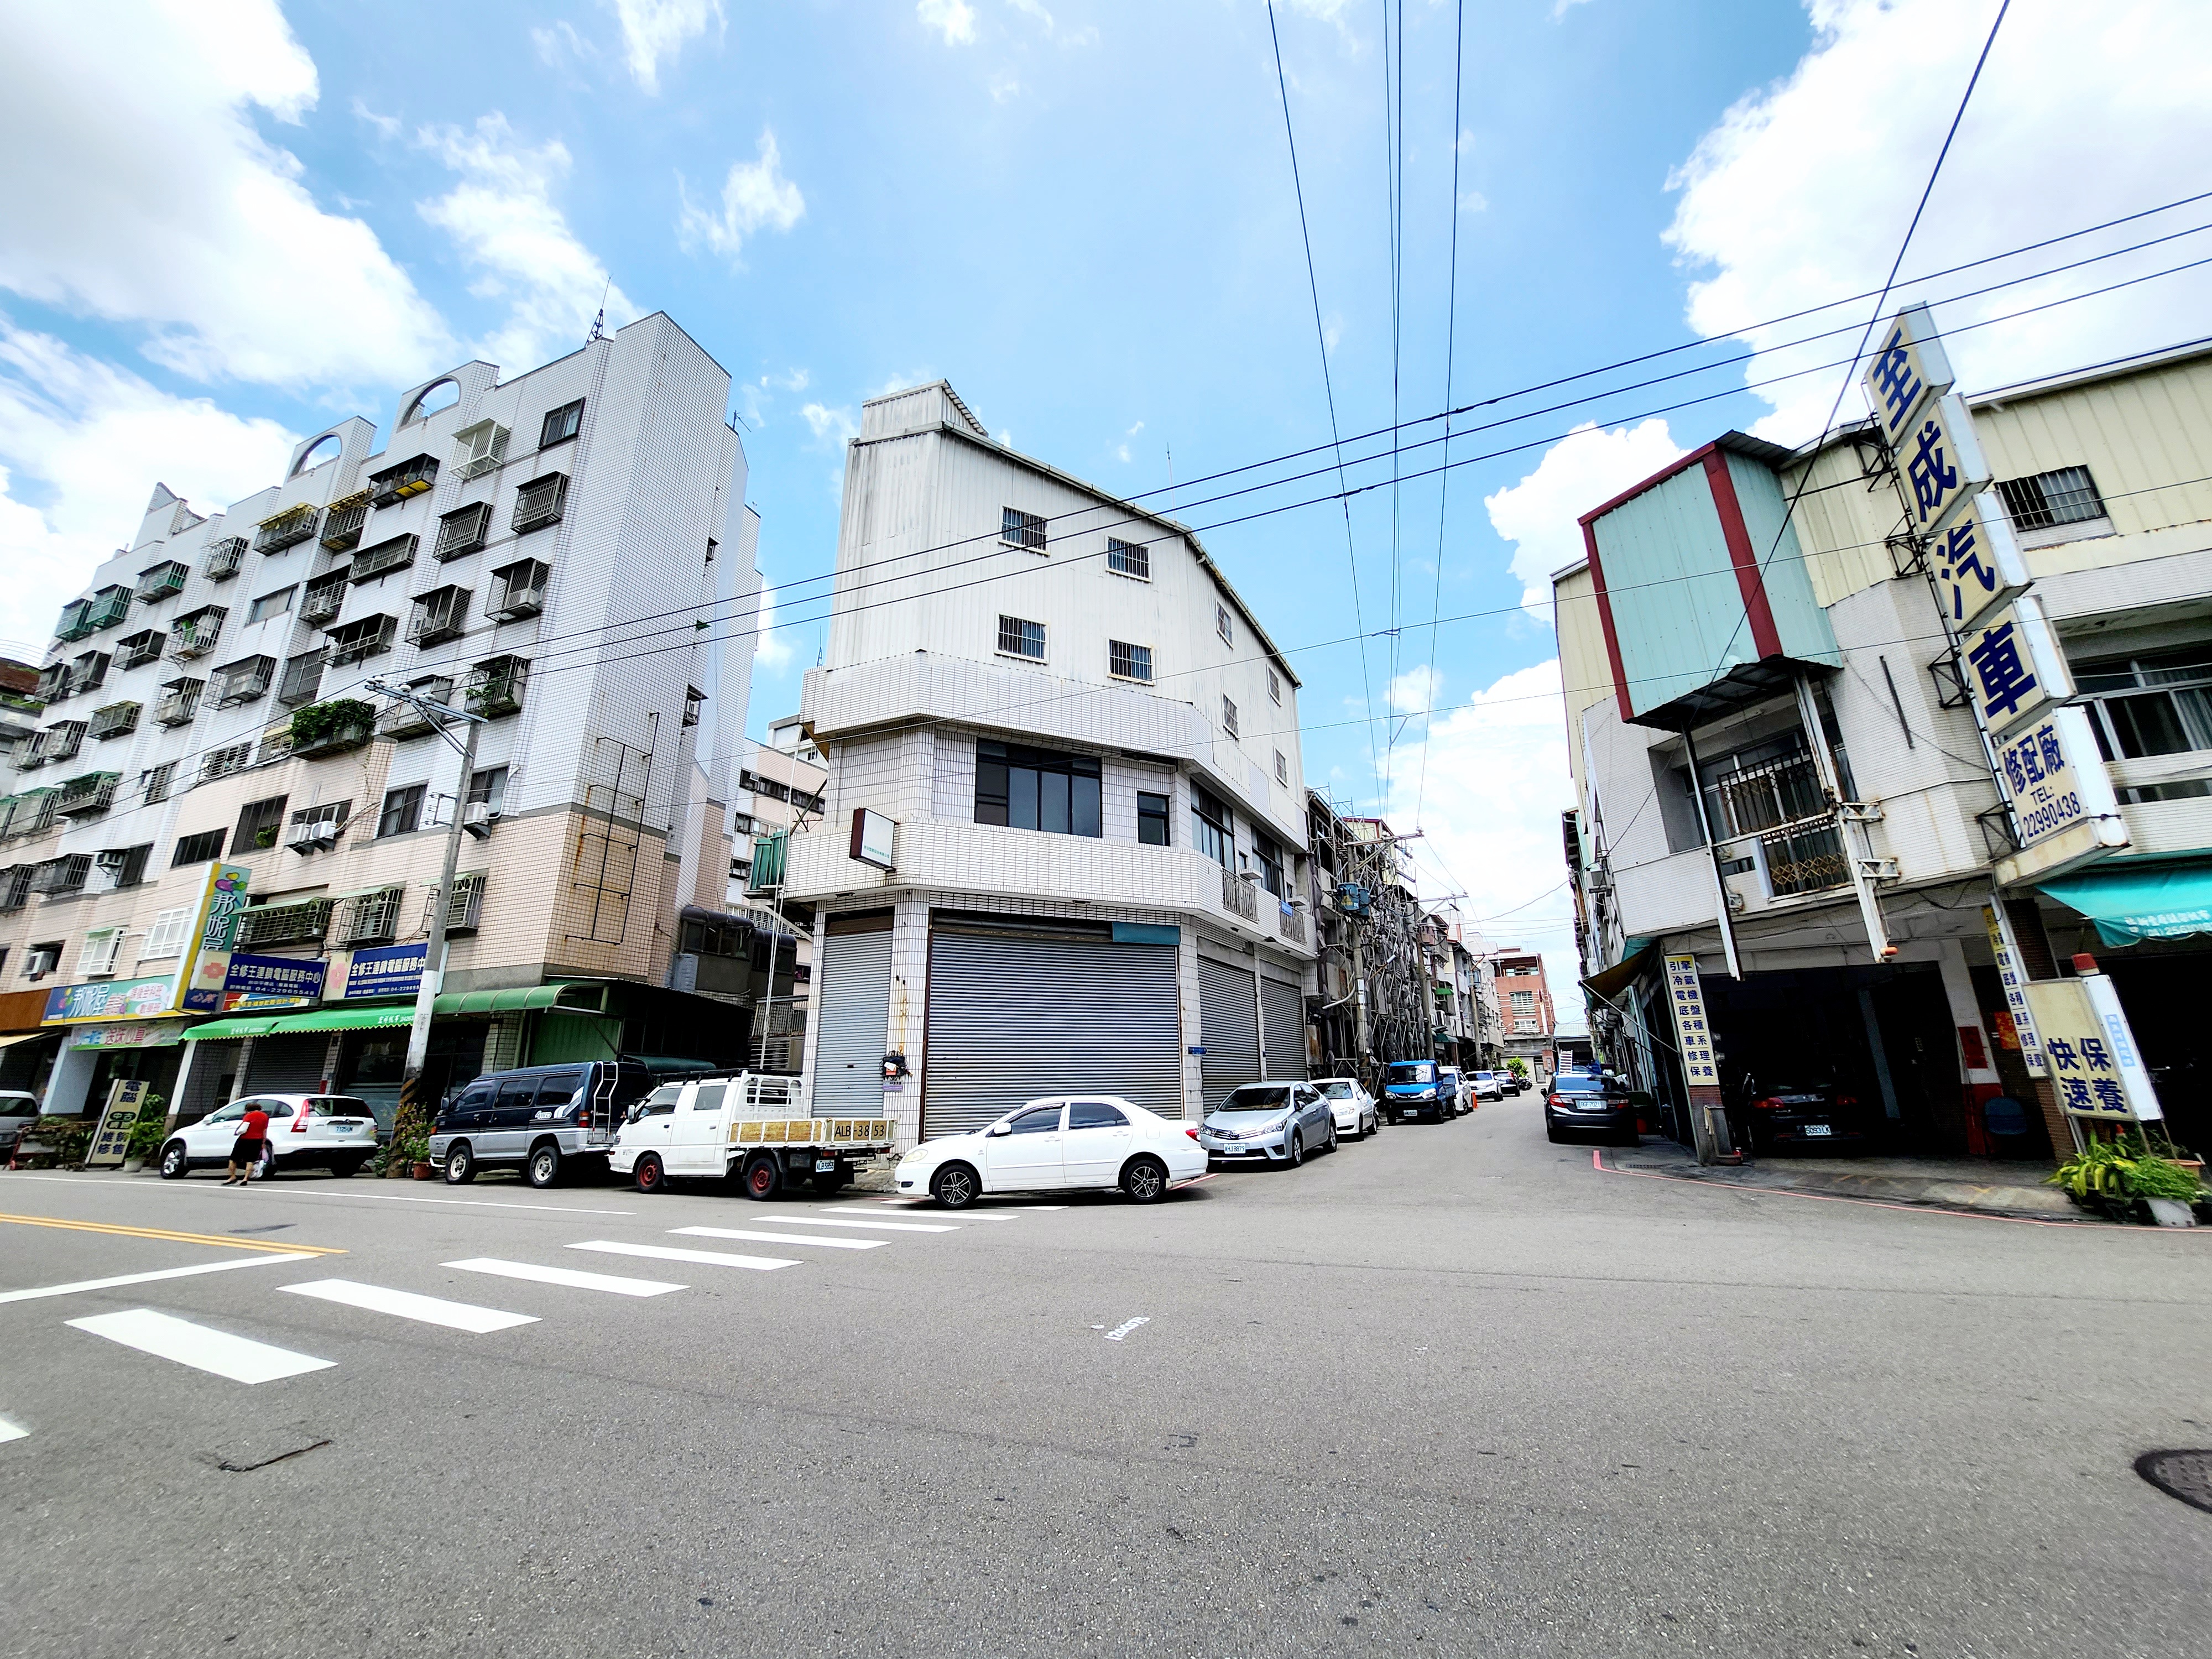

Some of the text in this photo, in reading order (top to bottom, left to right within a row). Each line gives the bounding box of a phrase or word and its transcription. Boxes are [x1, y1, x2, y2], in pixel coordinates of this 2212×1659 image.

[1872, 327, 2037, 718] 至成汽車
[2004, 723, 2065, 797] 修配廠
[2030, 785, 2055, 806] TEL:
[2023, 791, 2081, 838] 22990438
[1669, 961, 1692, 971] 引擎
[229, 963, 321, 984] 全修王連鎖電腦服務中心
[1672, 975, 1695, 986] 冷氣
[255, 986, 315, 995] 04-22965548
[1675, 990, 1698, 1000] 電機
[1679, 1005, 1702, 1015] 底盤
[1682, 1020, 1704, 1031] 各種
[1684, 1035, 1707, 1046] 車系
[1688, 1050, 1711, 1061] 修理
[1690, 1066, 1713, 1077] 保養
[2047, 1037, 2095, 1111] 快速
[2080, 1038, 2128, 1114] 保養
[112, 1113, 133, 1121] 中古
[534, 1110, 552, 1119] 4WD
